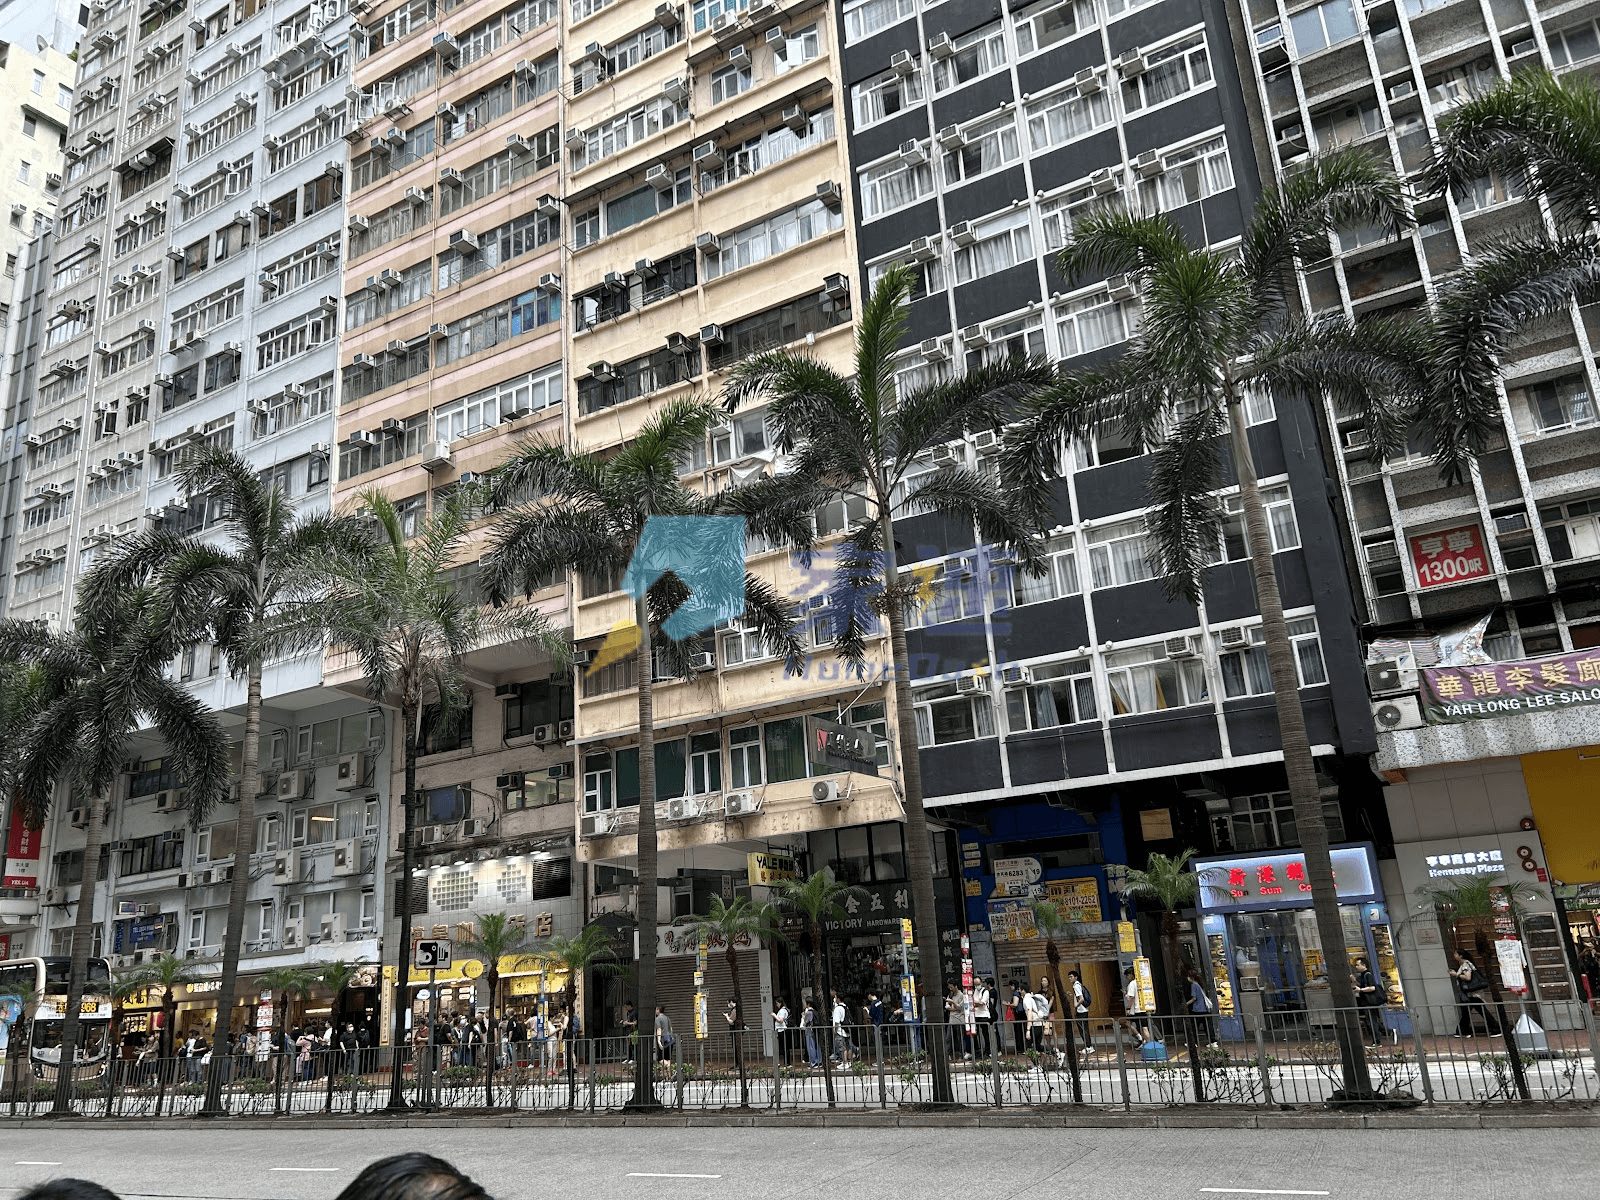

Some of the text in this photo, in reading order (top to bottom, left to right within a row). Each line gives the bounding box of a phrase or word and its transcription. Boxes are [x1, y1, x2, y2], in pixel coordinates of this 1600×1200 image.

[1442, 704, 1474, 717] YAH
[1478, 697, 1521, 714] LONG
[1527, 693, 1556, 709] LEE
[757, 855, 778, 869] YALE
[1428, 864, 1505, 878] Hennessy Plaza
[1230, 885, 1283, 898] Sun Sum
[825, 918, 863, 930] VICTORY
[81, 1002, 97, 1013] 968
